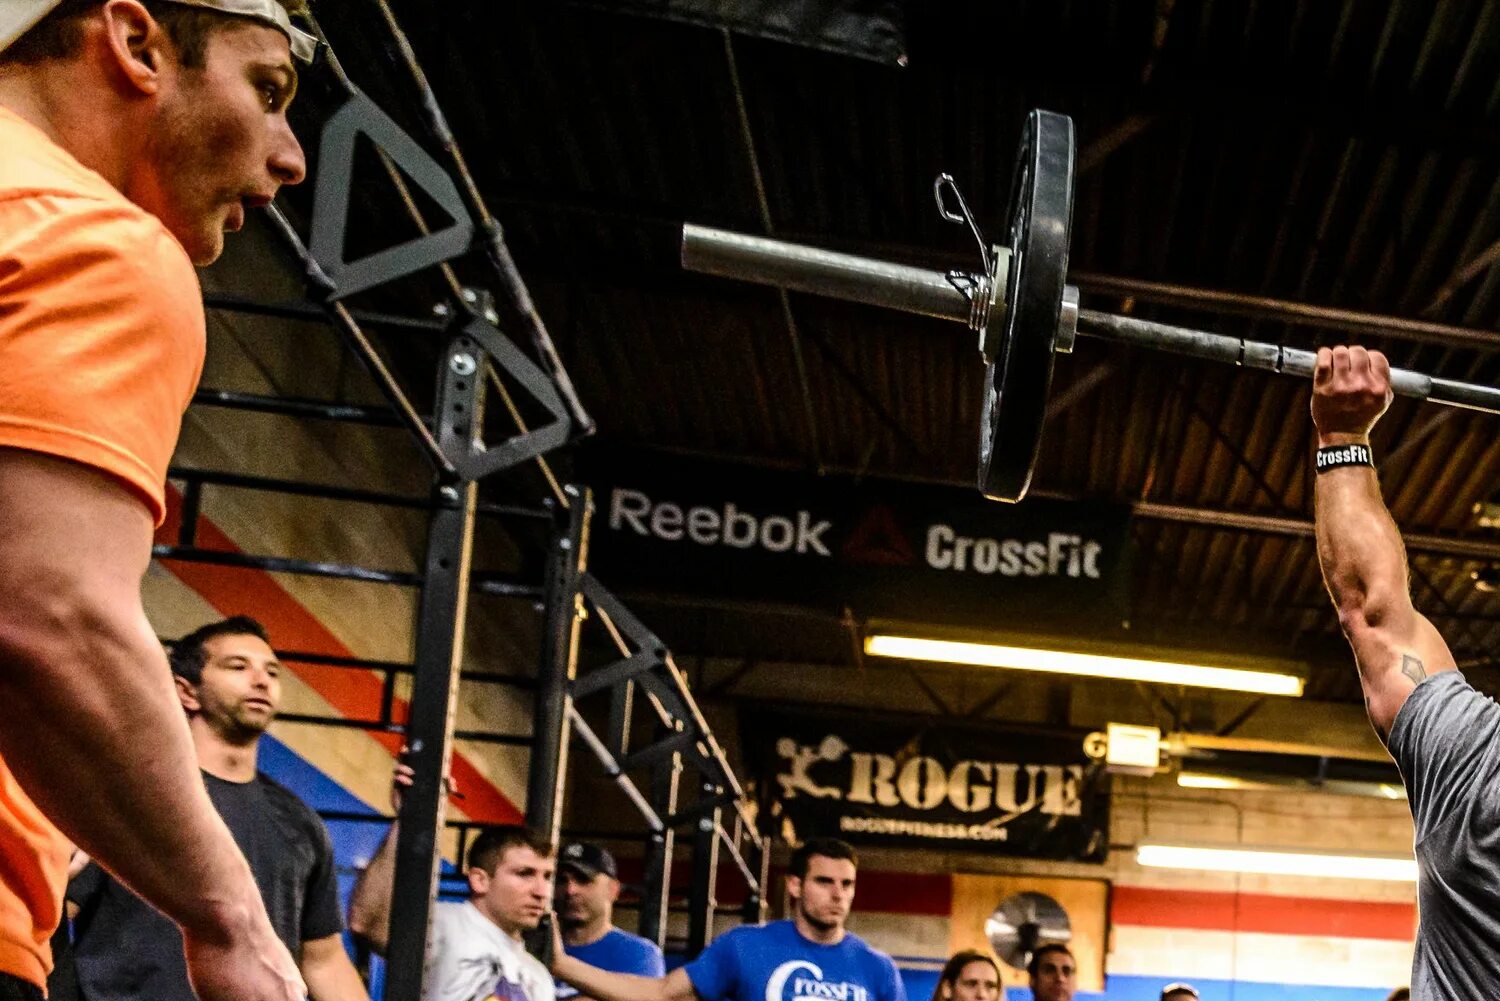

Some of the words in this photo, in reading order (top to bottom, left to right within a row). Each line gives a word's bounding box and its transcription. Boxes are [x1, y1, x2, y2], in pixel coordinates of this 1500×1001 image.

[1316, 445, 1368, 468] CrossFit
[608, 488, 833, 558] Reebok
[925, 525, 1102, 579] CrossFit
[846, 753, 1083, 816] ROGUE
